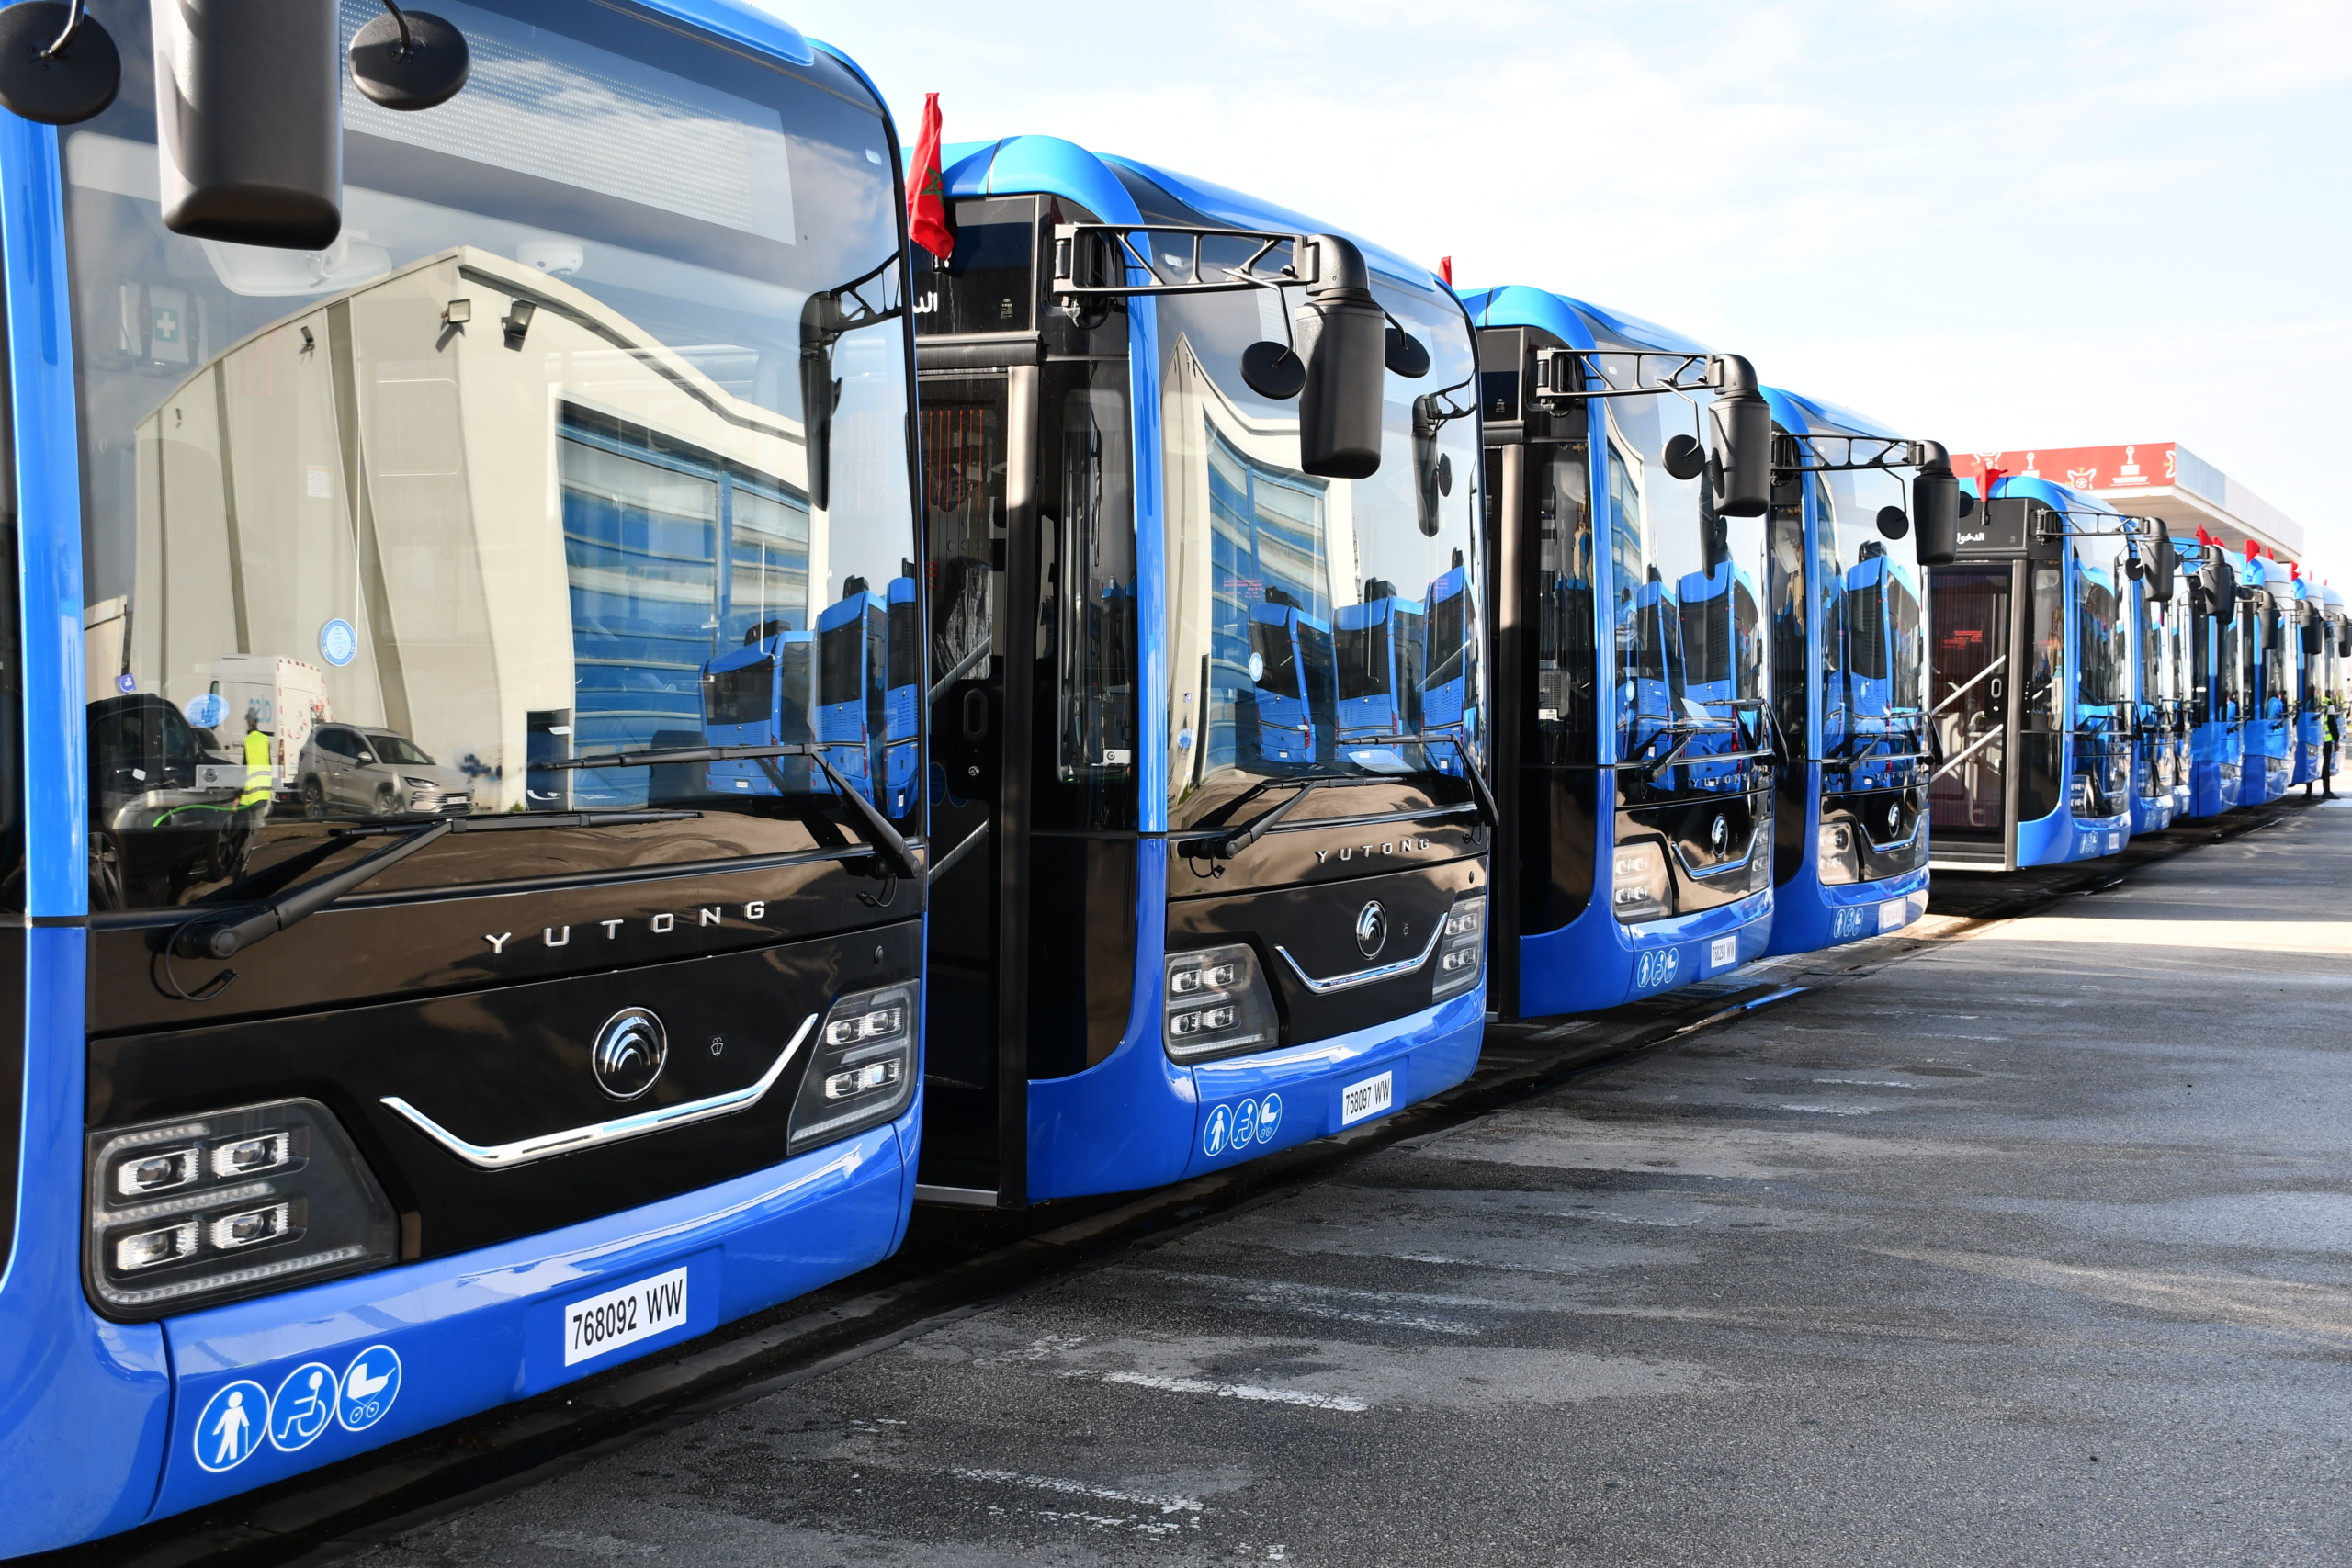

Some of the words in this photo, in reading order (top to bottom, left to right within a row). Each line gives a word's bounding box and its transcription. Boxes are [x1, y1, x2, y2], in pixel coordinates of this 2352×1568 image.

[1315, 838, 1430, 864] YUTONG
[483, 900, 766, 955] YUTONG
[1345, 1085, 1372, 1117] 768097
[1374, 1077, 1391, 1105] WW
[572, 1295, 638, 1350] 768092
[645, 1278, 684, 1325] WW
